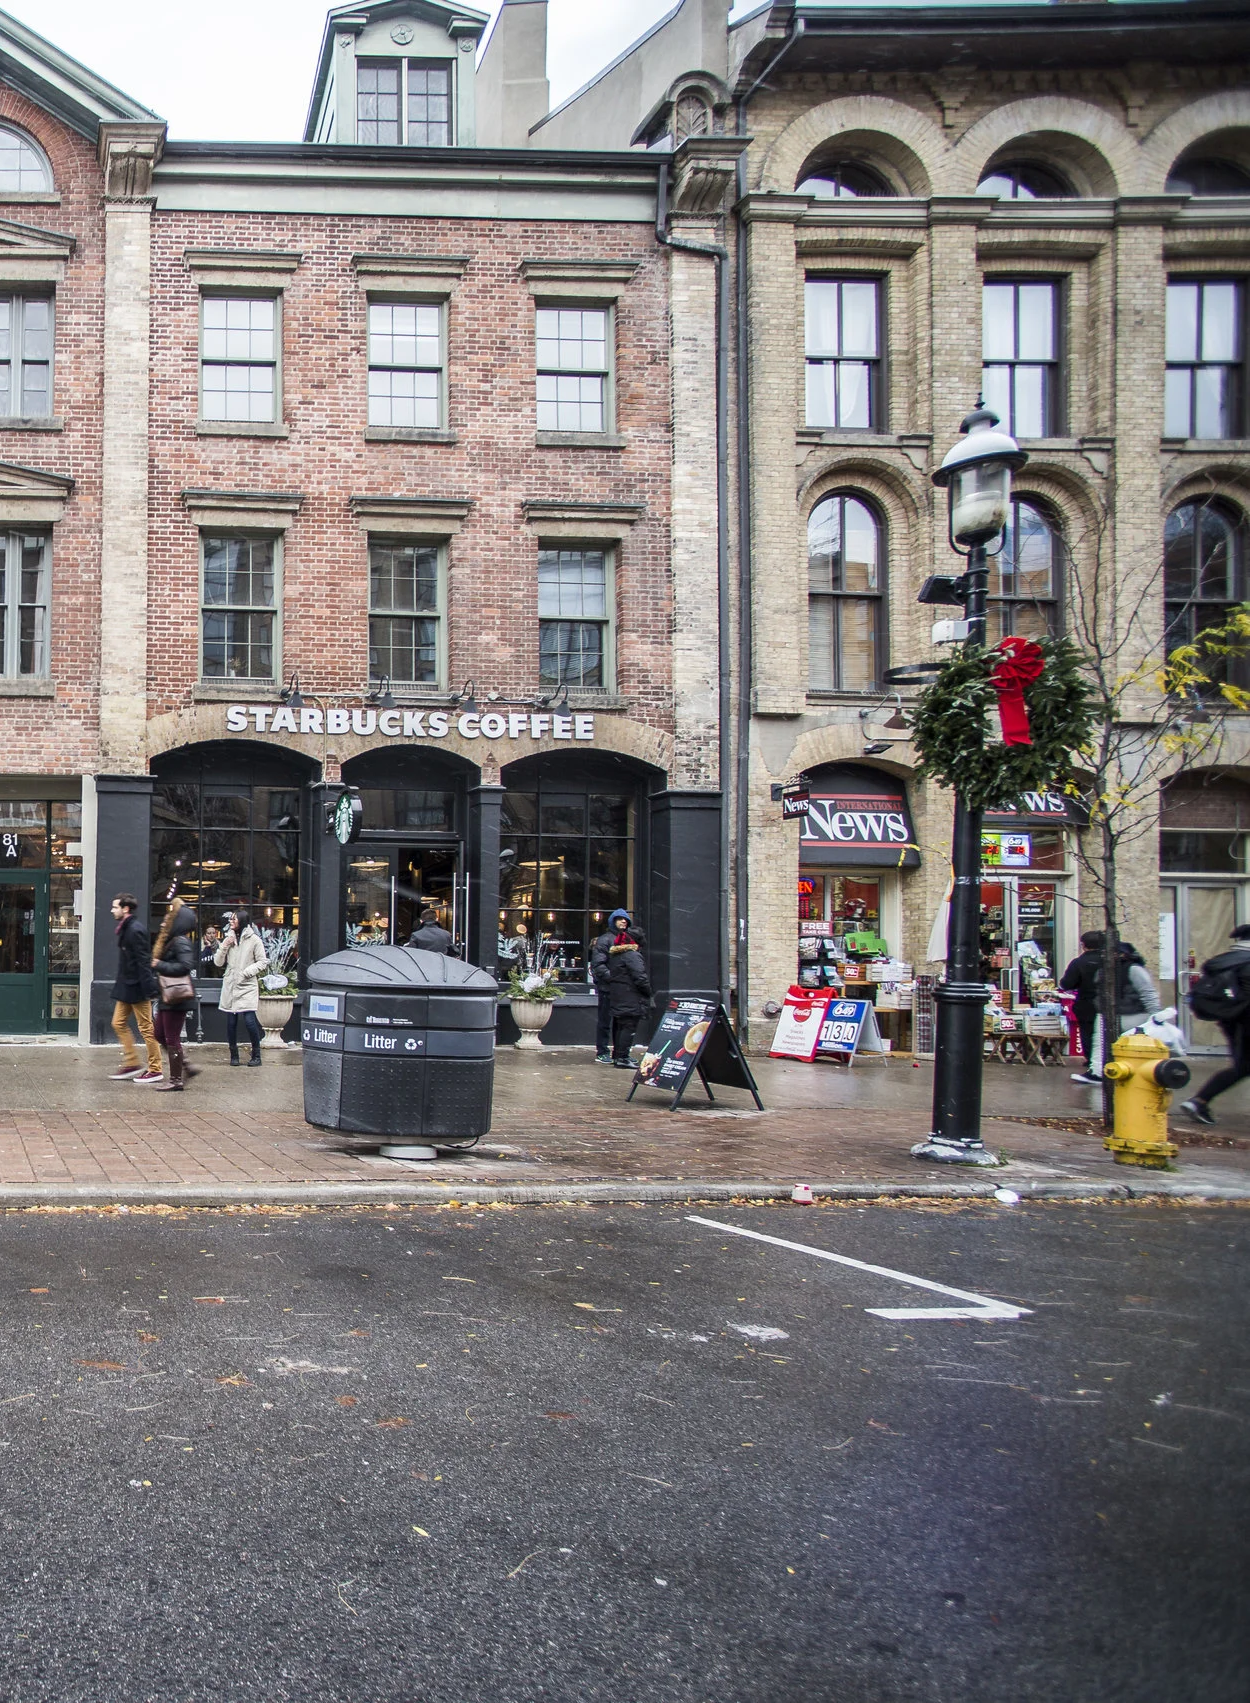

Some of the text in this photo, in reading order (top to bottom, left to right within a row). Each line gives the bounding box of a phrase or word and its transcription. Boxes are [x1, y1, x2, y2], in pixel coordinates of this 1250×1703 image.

[226, 705, 594, 740] STARBUCKS COFFEE
[783, 797, 809, 814] News
[836, 800, 904, 811] INTERNATIONAL
[800, 799, 909, 842] News
[2, 833, 18, 846] 81
[5, 844, 17, 857] A
[798, 881, 812, 893] EN
[802, 922, 830, 930] FREE
[314, 1027, 338, 1044] Litter
[364, 1033, 398, 1050] Litter
